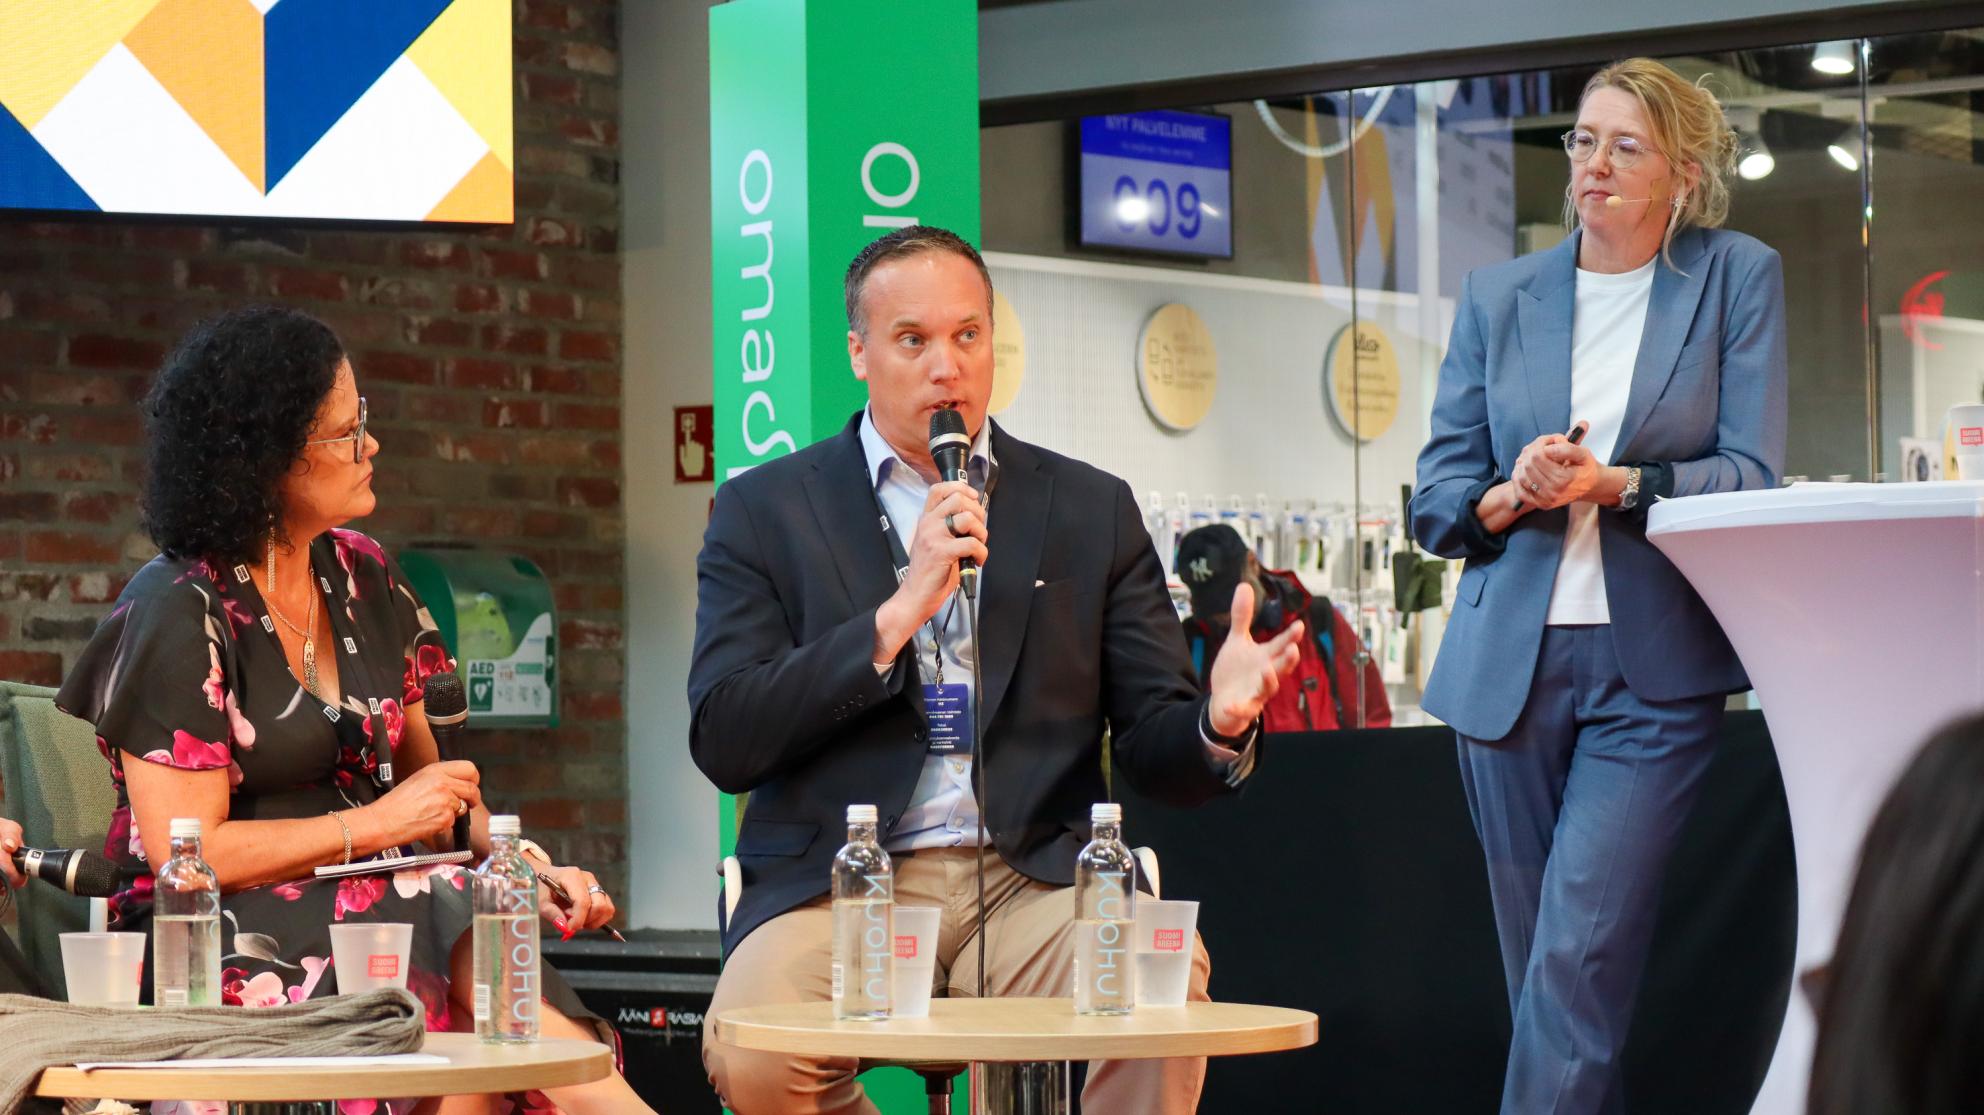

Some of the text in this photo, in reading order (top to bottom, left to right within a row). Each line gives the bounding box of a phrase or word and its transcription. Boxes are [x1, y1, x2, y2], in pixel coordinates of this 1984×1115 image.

[470, 662, 495, 674] AED
[511, 888, 538, 1022] KUOHU
[864, 874, 891, 1001] KUOHU
[1096, 871, 1126, 996] KUOHU
